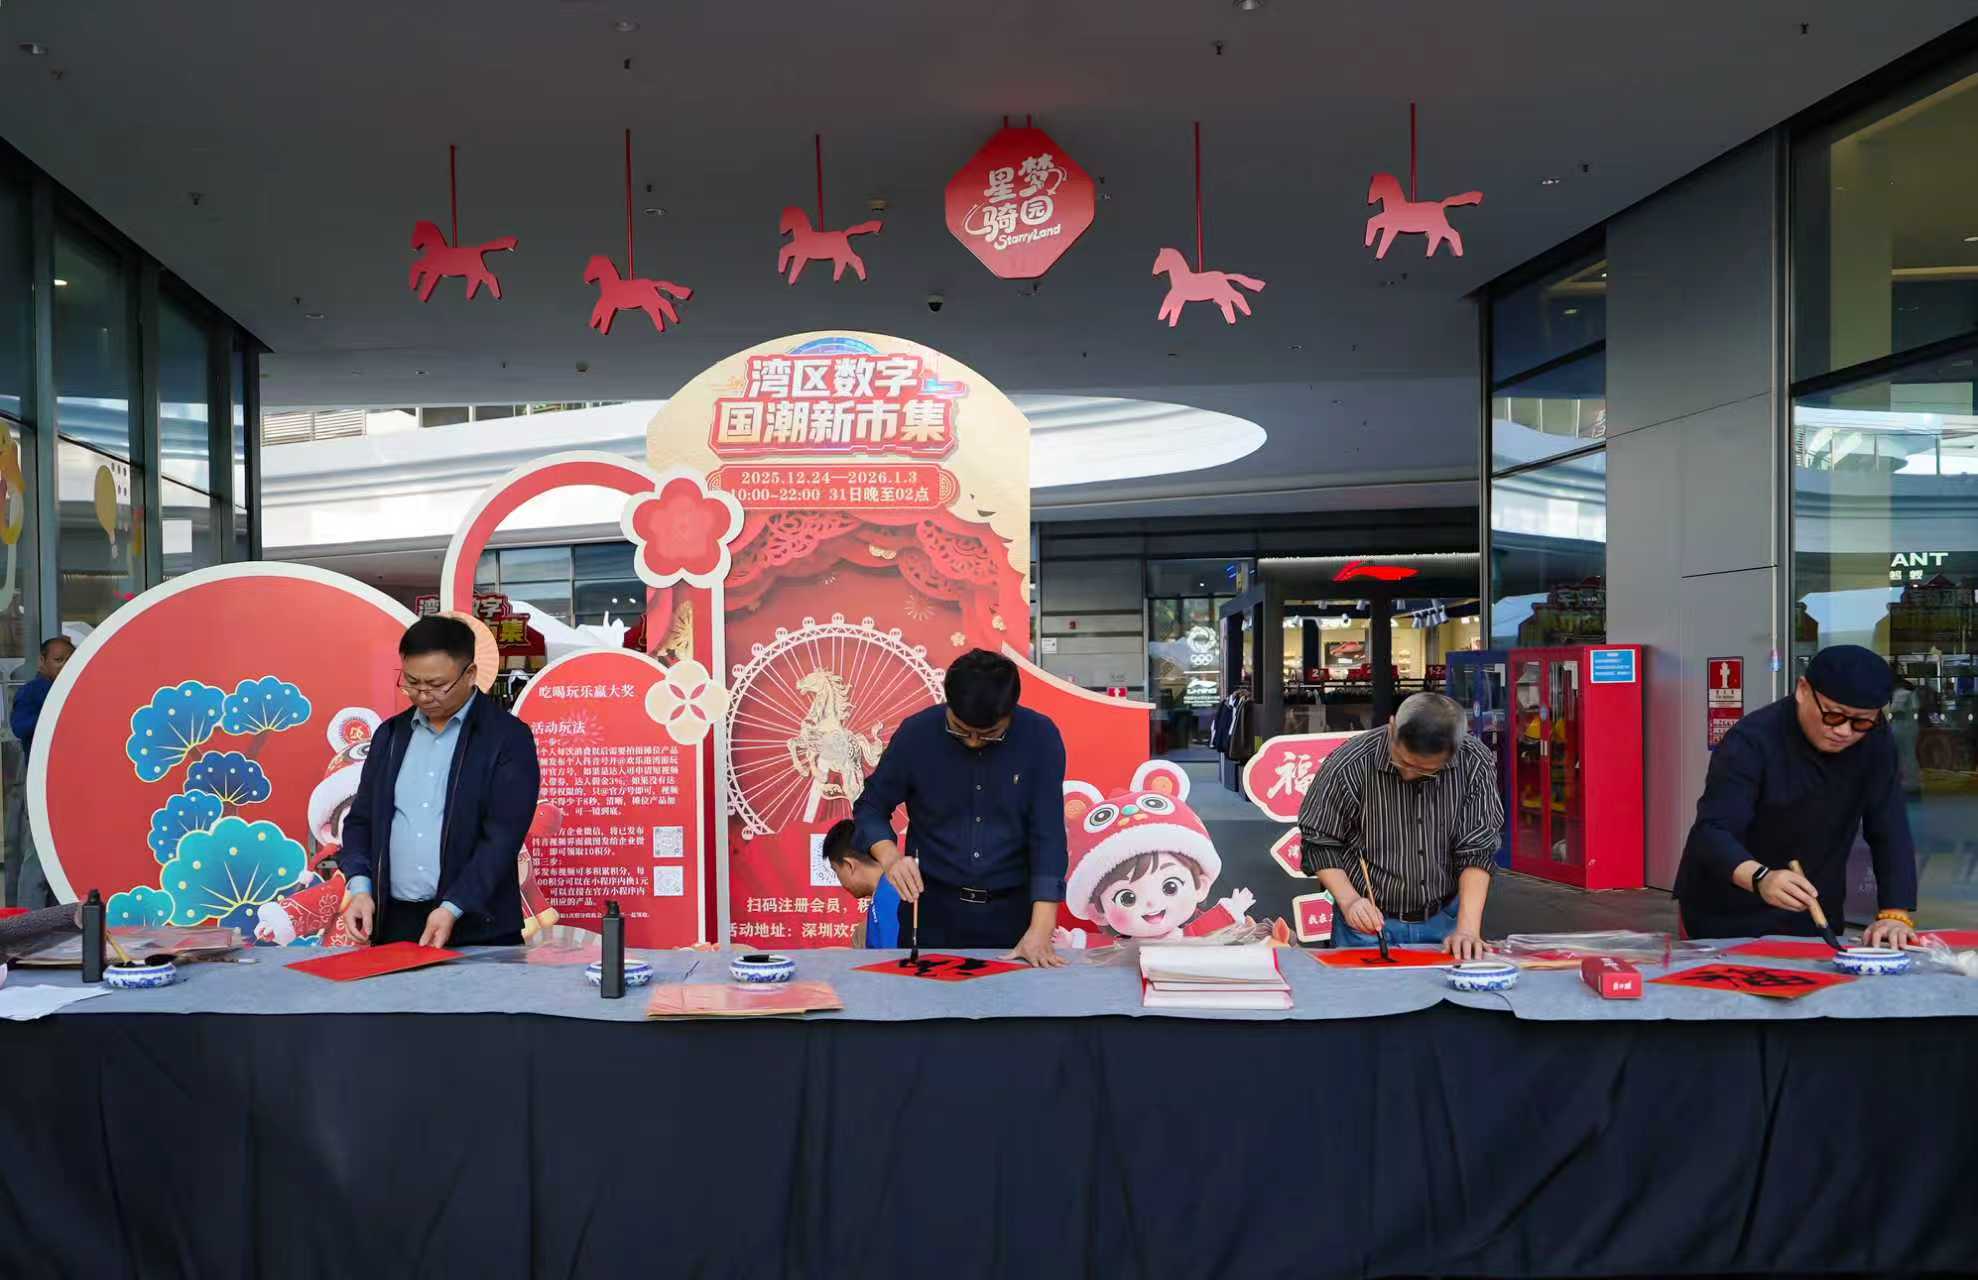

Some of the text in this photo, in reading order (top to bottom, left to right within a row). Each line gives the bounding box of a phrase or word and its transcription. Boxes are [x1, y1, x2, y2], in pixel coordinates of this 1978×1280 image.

[994, 224, 1061, 250] StarryLand
[748, 358, 921, 399] 湾区数字
[716, 400, 947, 444] 国潮新市集
[829, 487, 930, 503] 31日晚至02点
[1890, 552, 1949, 567] ANT
[538, 684, 636, 699] 吃喝玩乐赢大奖
[531, 721, 586, 734] 活动玩法
